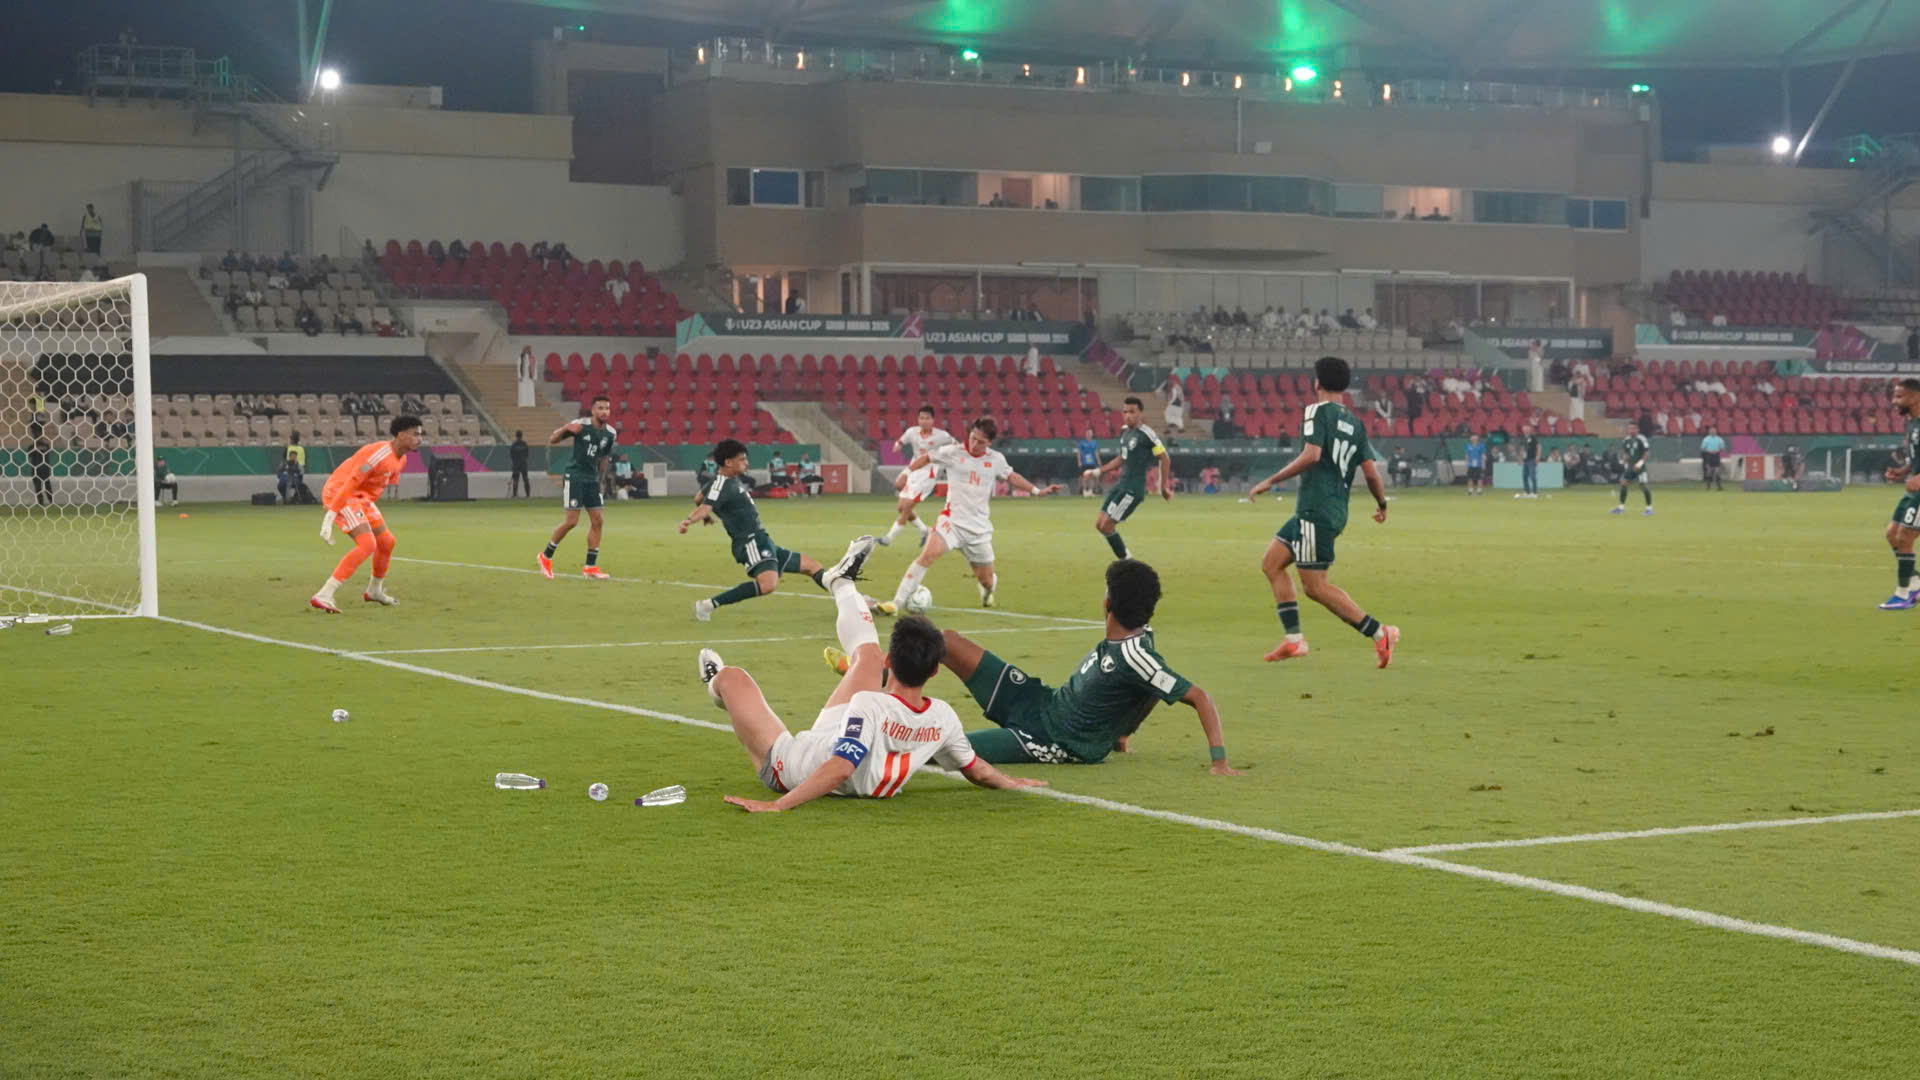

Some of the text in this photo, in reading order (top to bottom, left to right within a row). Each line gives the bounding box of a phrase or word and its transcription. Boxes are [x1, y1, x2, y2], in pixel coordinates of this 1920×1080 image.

[741, 319, 762, 330] U23
[763, 319, 797, 330] ASIAN
[798, 319, 821, 330] CUP
[926, 332, 946, 343] U23
[947, 332, 980, 343] ASIAN
[981, 332, 1004, 343] CUP
[586, 442, 598, 457] 12
[1332, 437, 1357, 479] 14
[1903, 506, 1916, 524] 6
[835, 741, 864, 760] AFC
[871, 752, 912, 798] 11
